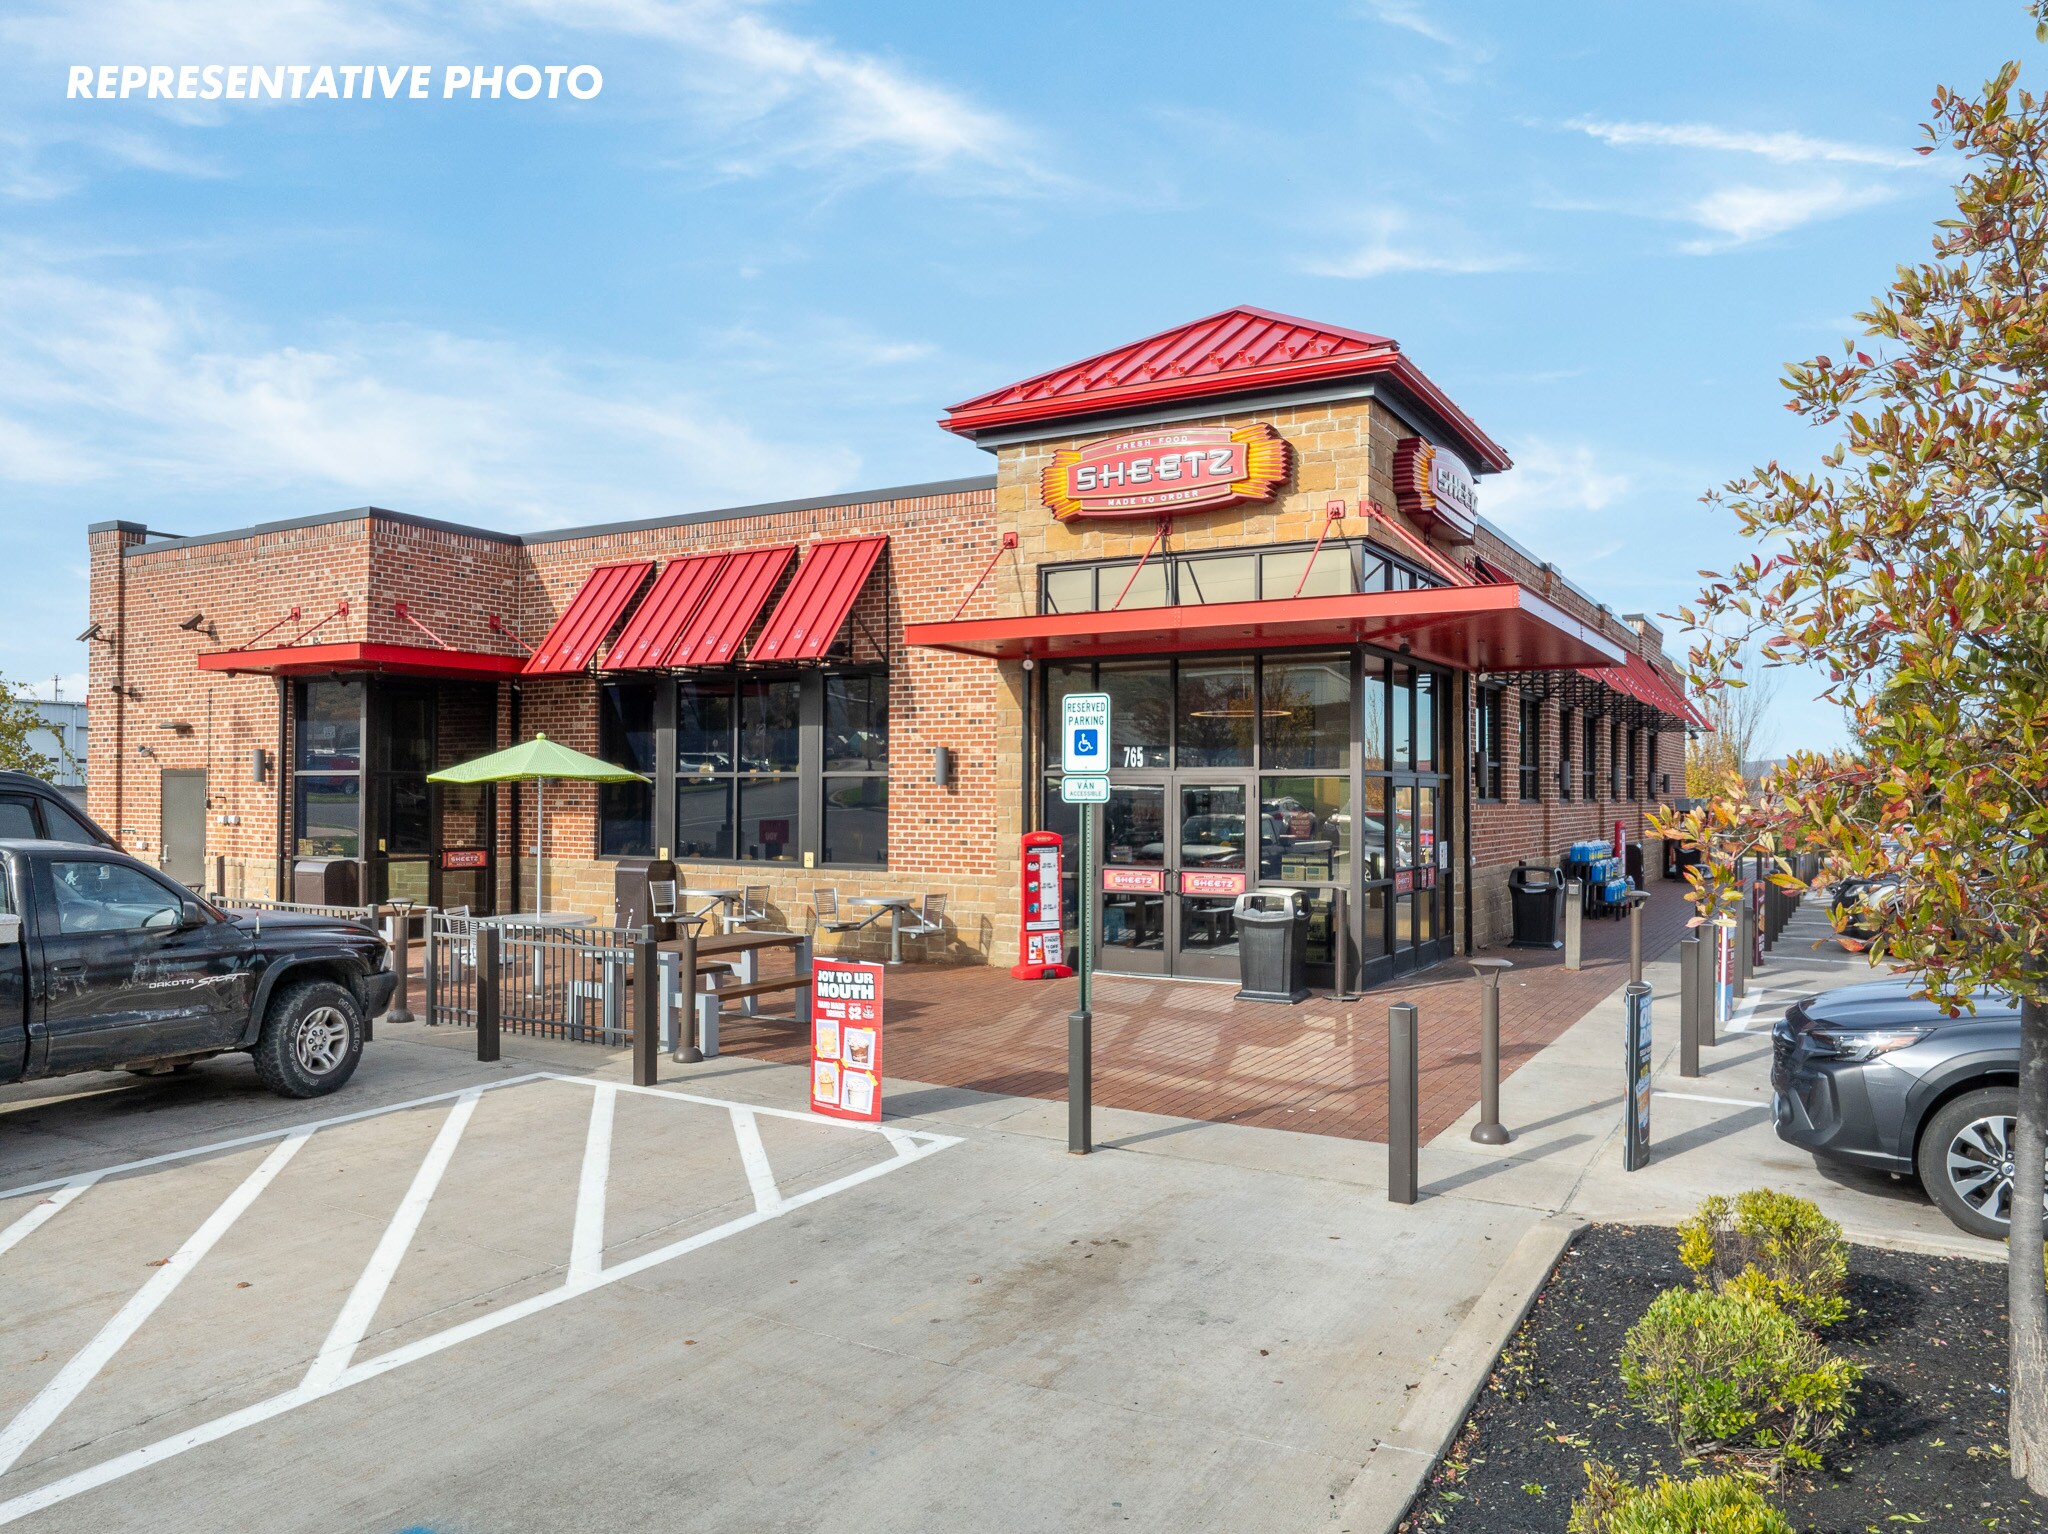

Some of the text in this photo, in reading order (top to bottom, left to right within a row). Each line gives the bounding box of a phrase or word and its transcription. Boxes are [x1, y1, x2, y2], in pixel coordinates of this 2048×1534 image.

[1116, 435, 1189, 451] FRESH FOOD
[1076, 449, 1234, 492] SHEETZ
[1107, 490, 1199, 507] MADE TO ORDER
[1067, 702, 1106, 713] RESERVED
[1068, 716, 1104, 726] PARKING
[1123, 746, 1144, 768] 765
[1077, 782, 1095, 790] VAN
[1114, 876, 1153, 885] SHEETZ
[1193, 880, 1233, 888] SHEETZ
[148, 973, 250, 990] DAKOTA SPORT
[817, 970, 874, 984] JOY TO UR
[817, 982, 875, 1000] MOUTH
